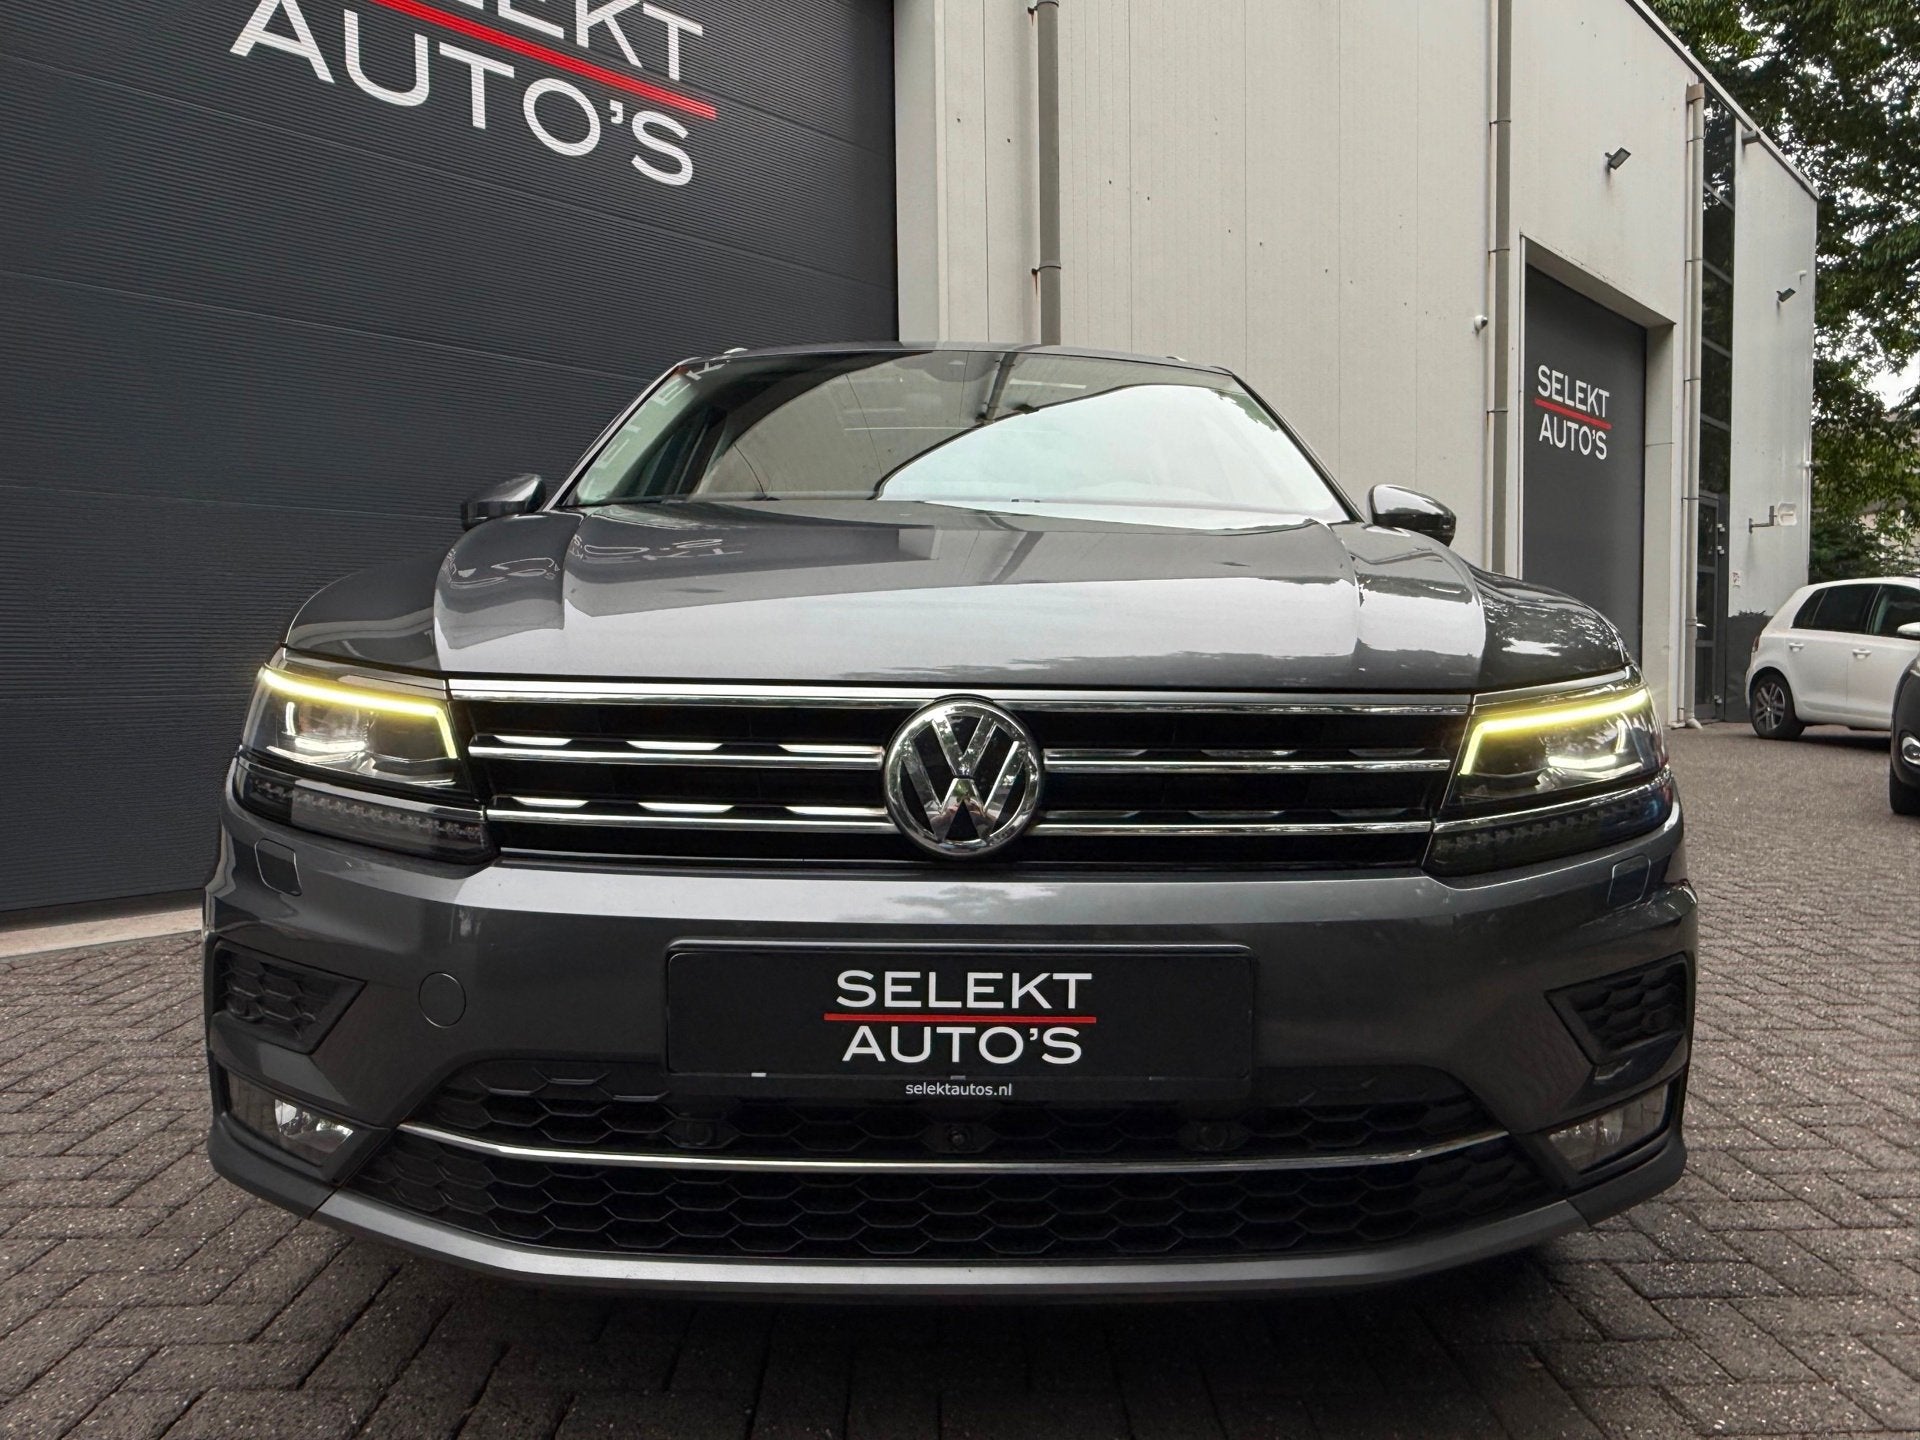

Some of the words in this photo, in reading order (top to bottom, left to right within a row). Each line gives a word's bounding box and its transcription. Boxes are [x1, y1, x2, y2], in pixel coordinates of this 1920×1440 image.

[229, 0, 695, 186] AUTO'S
[1537, 364, 1610, 418] SELEKT
[1538, 413, 1608, 460] AUTO'S
[836, 969, 1093, 1009] SELEKT
[842, 1025, 1082, 1065] AUTO'S
[905, 1081, 1012, 1096] selektautos.nl
